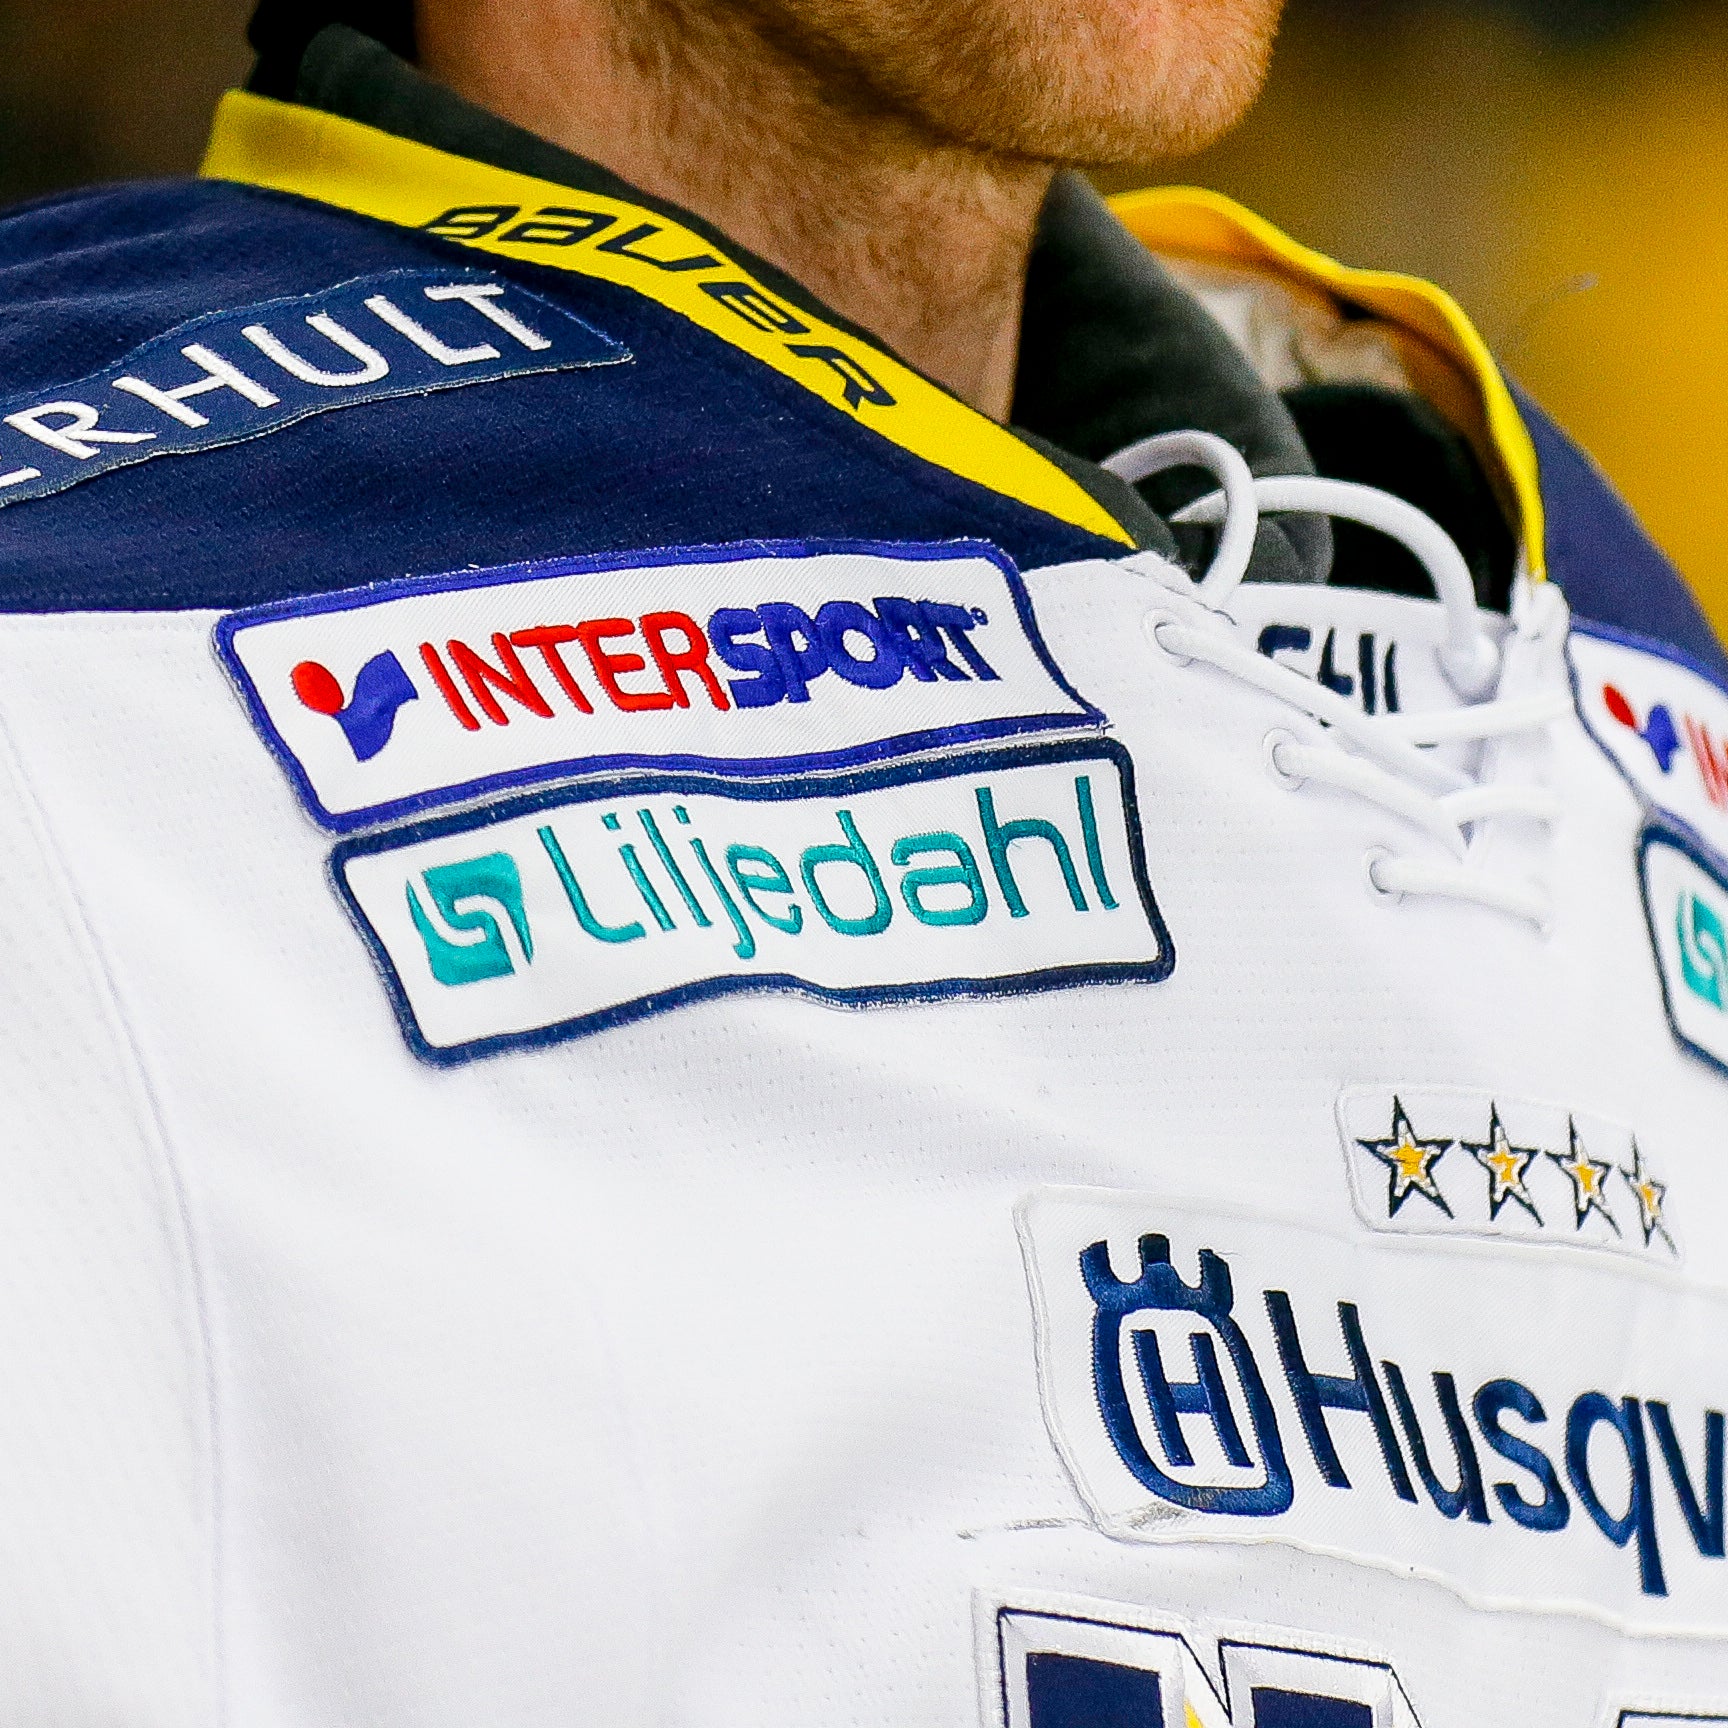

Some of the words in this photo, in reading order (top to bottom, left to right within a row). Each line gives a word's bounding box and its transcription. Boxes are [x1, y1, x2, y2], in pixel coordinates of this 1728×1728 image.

[424, 203, 898, 411] BAUER
[417, 596, 1002, 733] INTERSPORT
[536, 774, 1121, 961] Liljedahl
